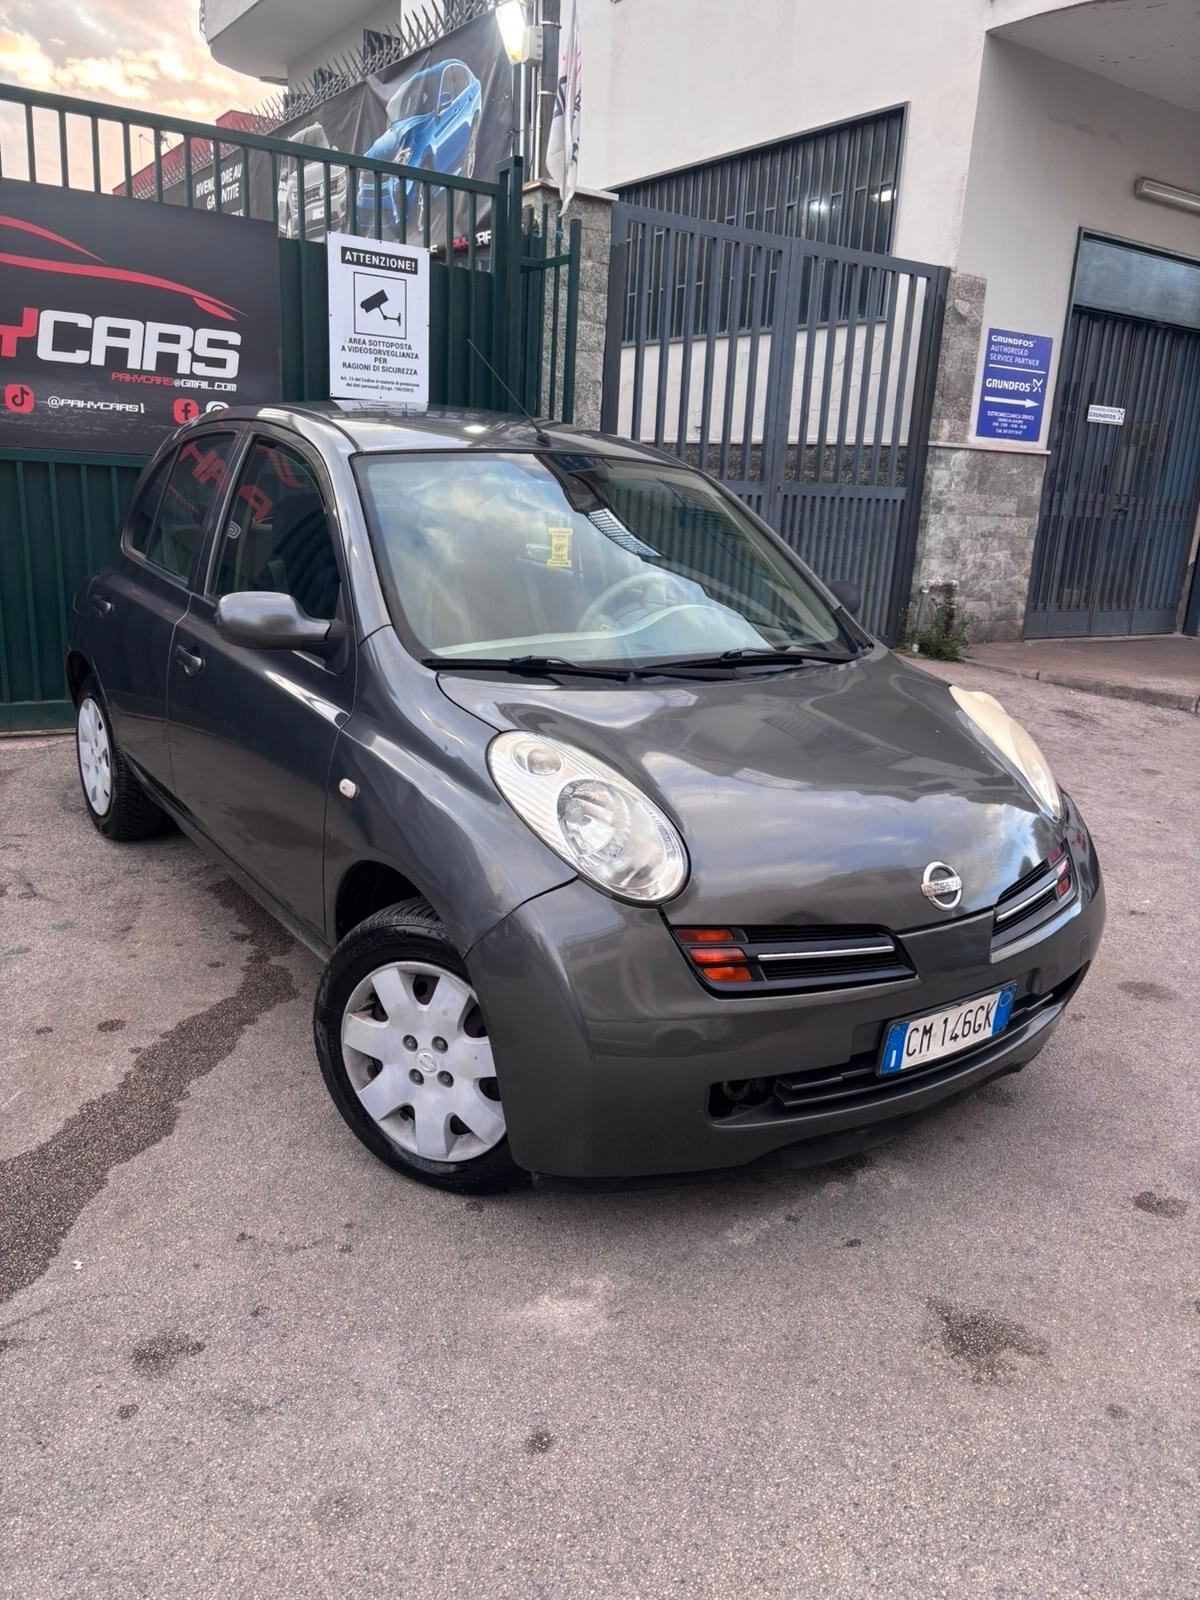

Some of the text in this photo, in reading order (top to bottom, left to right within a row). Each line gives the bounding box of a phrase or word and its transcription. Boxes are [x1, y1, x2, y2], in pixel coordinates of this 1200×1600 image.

[345, 250, 416, 271] ATTENZIONE!
[348, 337, 413, 351] AREA SOTTOPOSTA
[991, 335, 1034, 347] GRUNDFOS
[347, 345, 419, 360] VIDEOSORVEGLIANZA
[990, 344, 1029, 356] AUTHORISED
[374, 357, 387, 365] PER
[989, 353, 1040, 366] SERVICE PARTNER
[342, 361, 371, 370] RAGIONI
[381, 366, 418, 376] SICUREZZA
[986, 378, 1031, 392] GRUNDFOS
[906, 1022, 934, 1057] CM
[941, 1000, 997, 1046] 146GK
